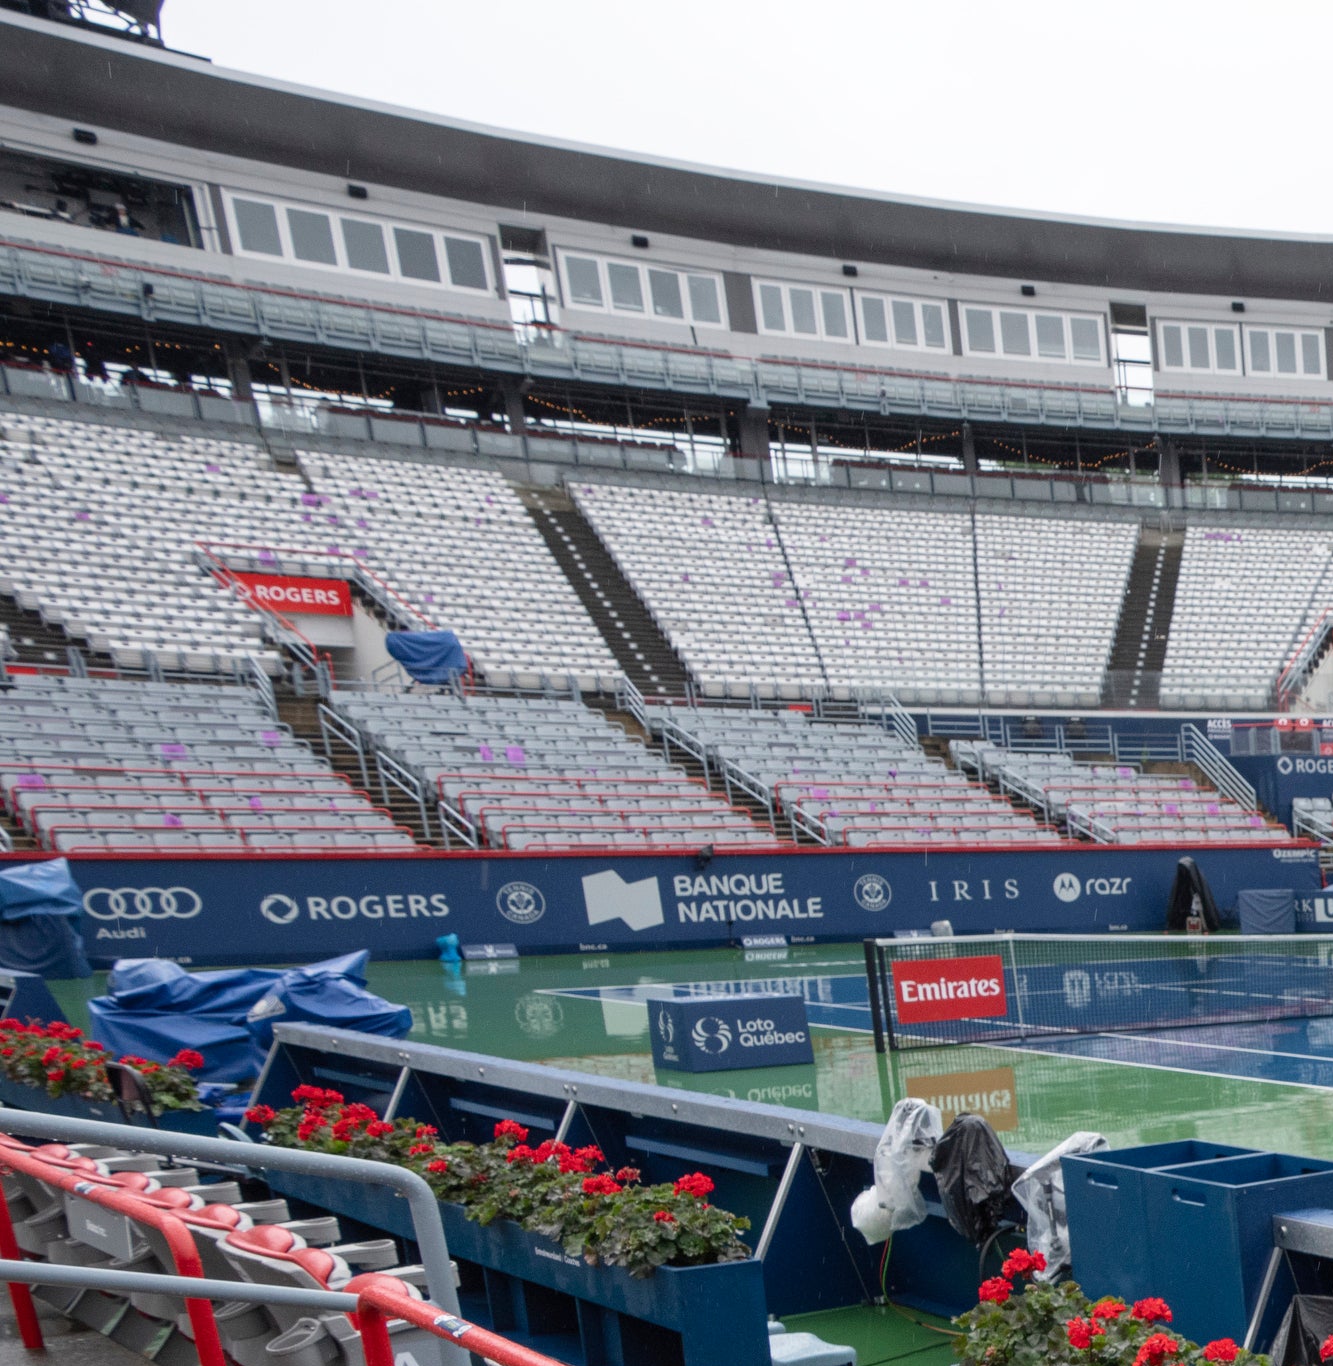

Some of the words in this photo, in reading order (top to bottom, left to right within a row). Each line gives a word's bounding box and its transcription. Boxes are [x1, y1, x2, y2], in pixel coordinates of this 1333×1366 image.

[254, 584, 340, 605] ROGERS
[673, 873, 785, 897] BANQUE
[929, 879, 1021, 901] IRIS
[1085, 877, 1132, 896] razr
[308, 892, 450, 921] ROGERS
[677, 897, 824, 923] NATIONALE
[95, 926, 147, 940] Audi
[752, 935, 787, 947] ROGERS
[899, 976, 1001, 1003] Emirates
[737, 1017, 775, 1033] Loto
[739, 1030, 807, 1048] Québec
